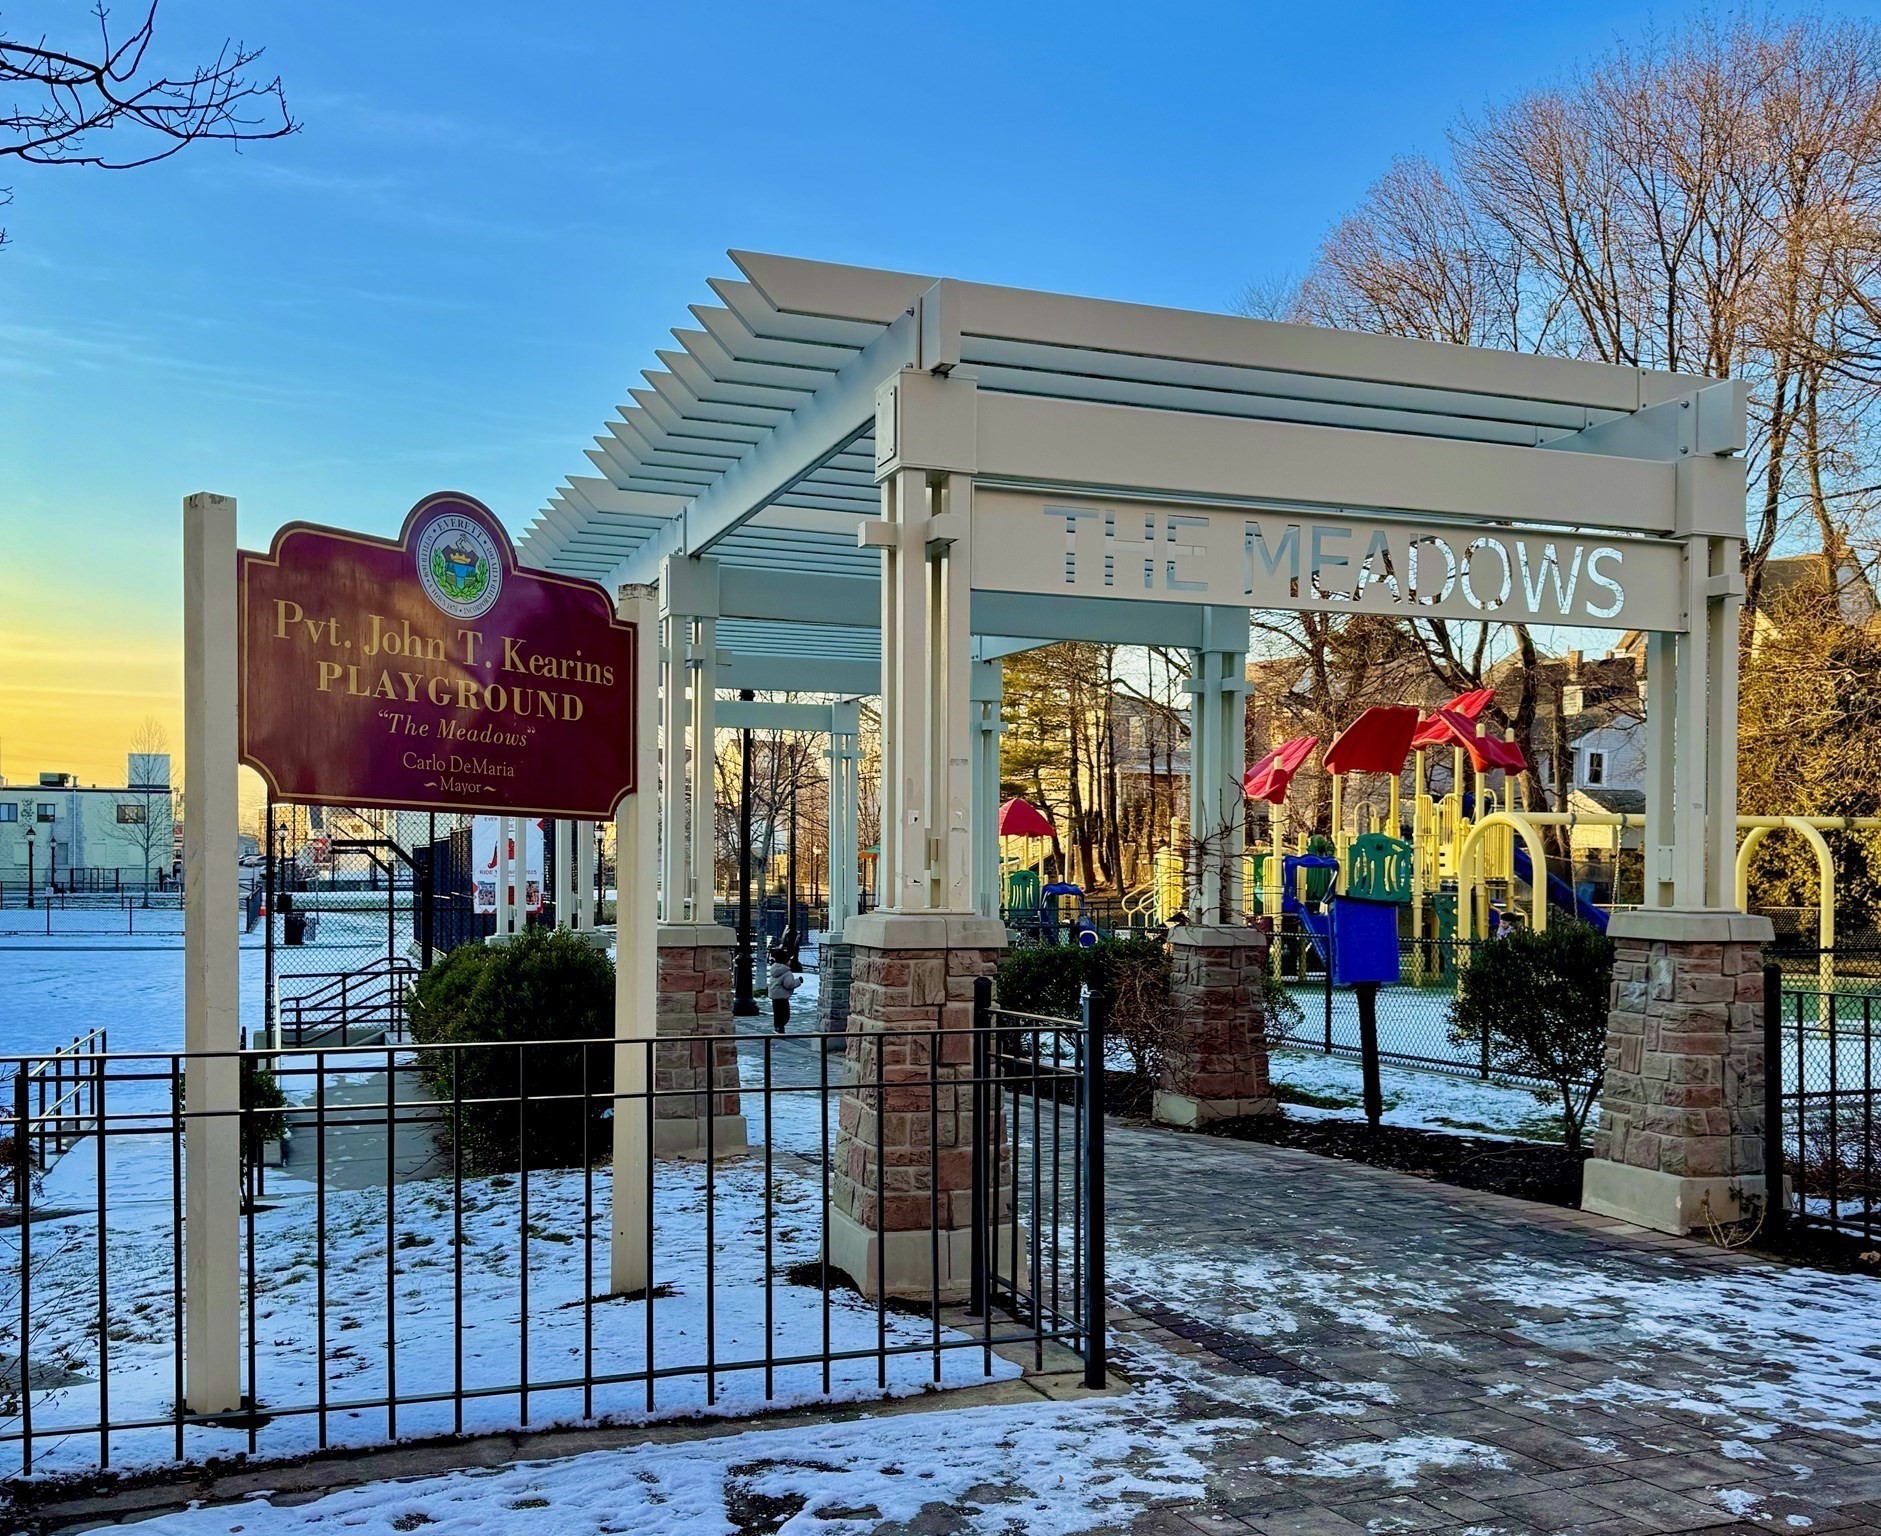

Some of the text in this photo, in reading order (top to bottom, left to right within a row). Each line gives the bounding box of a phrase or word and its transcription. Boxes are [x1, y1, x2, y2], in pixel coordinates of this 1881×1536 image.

[437, 519, 483, 538] EVERETT
[422, 535, 432, 562] SETTLED
[1043, 505, 1625, 619] THE MEADOWS
[464, 584, 497, 614] INCORPORATED
[273, 599, 614, 686] Pvt. John T. Kearins
[317, 660, 584, 721] PLAYGROUND
[378, 709, 536, 747] “The Meadows”
[403, 751, 515, 778] Carlo DeMaria
